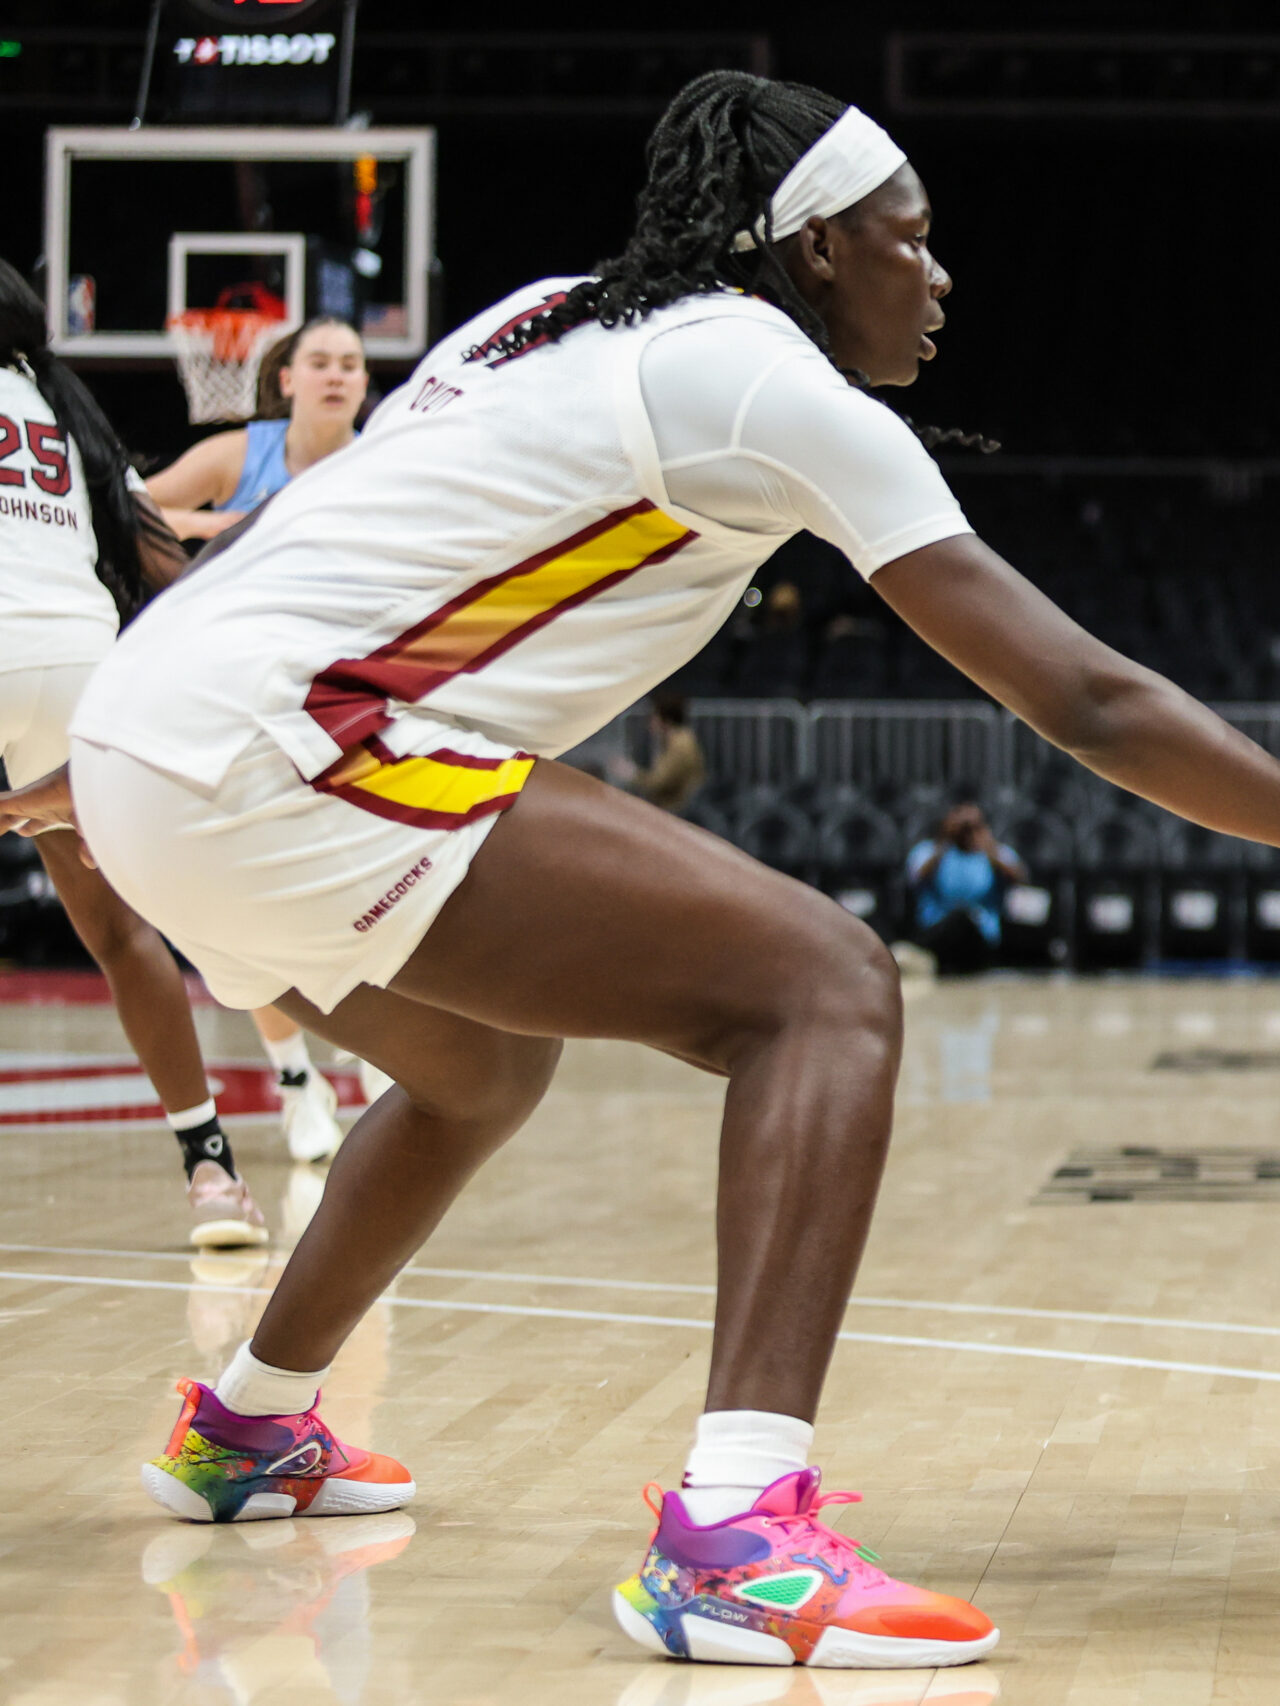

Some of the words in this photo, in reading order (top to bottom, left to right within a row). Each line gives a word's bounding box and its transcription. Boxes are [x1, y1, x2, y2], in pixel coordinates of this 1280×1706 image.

[218, 33, 336, 65] TISSOT
[0, 414, 71, 497] 25
[0, 497, 78, 530] OHNSON
[353, 857, 433, 933] GAMECOCKS
[702, 1603, 748, 1623] FLOW
